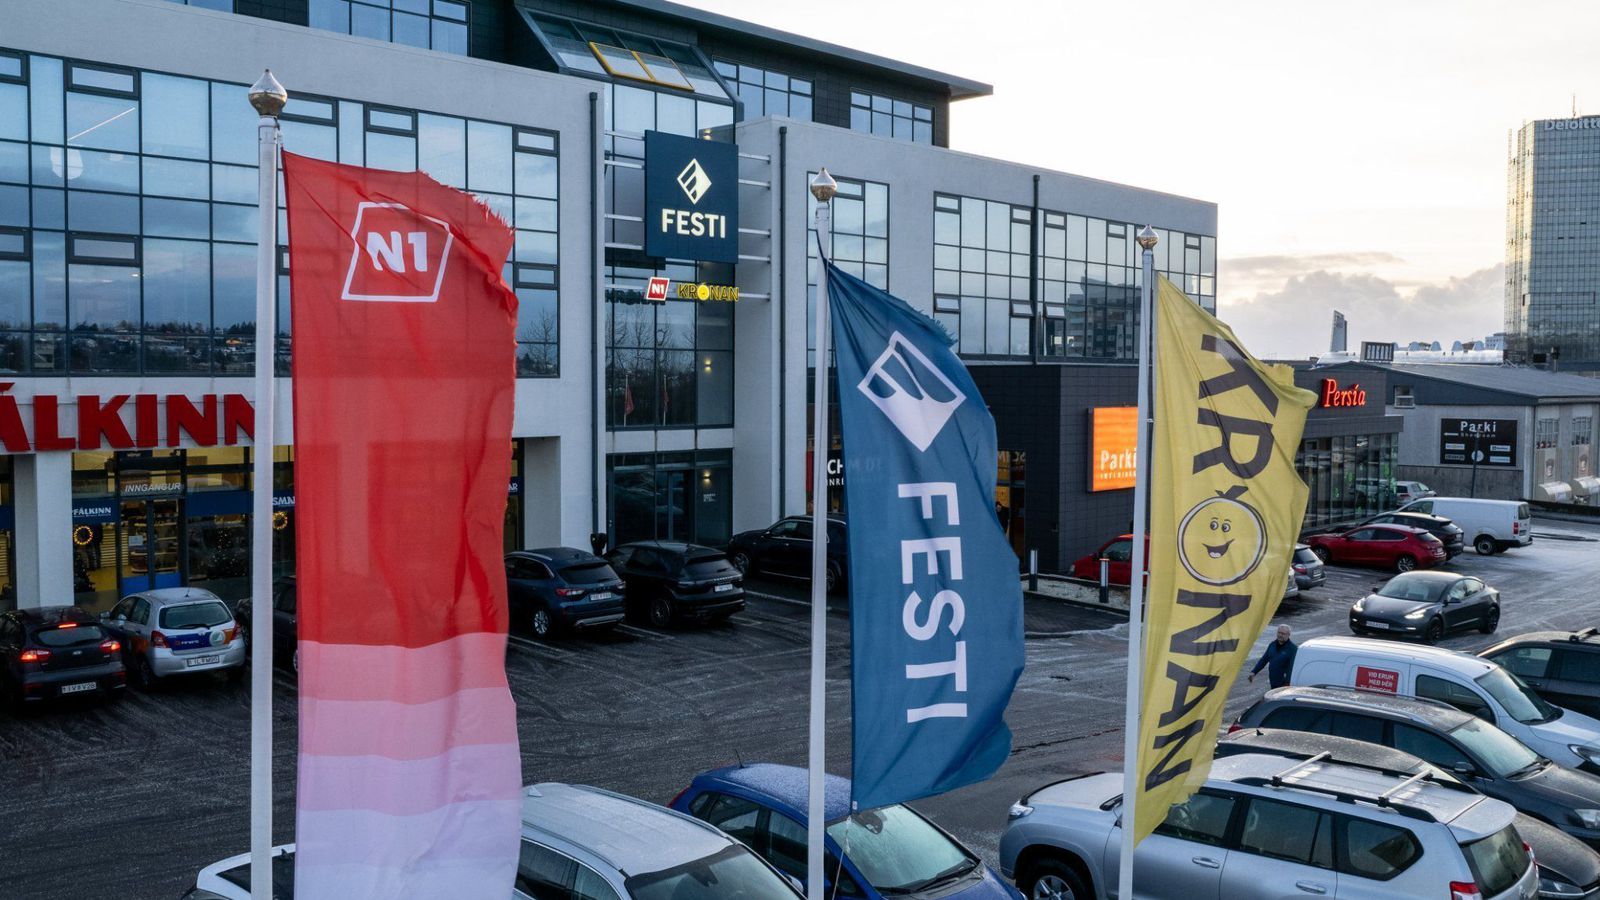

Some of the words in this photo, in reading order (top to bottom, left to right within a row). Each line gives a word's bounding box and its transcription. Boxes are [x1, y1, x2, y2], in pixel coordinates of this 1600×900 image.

[661, 208, 726, 239] FESTI
[366, 230, 428, 273] N1
[651, 283, 665, 295] N1
[1460, 421, 1497, 433] Parki
[1100, 448, 1137, 471] Parki
[125, 482, 181, 493] INNGANGUR
[898, 482, 968, 724] FESTI
